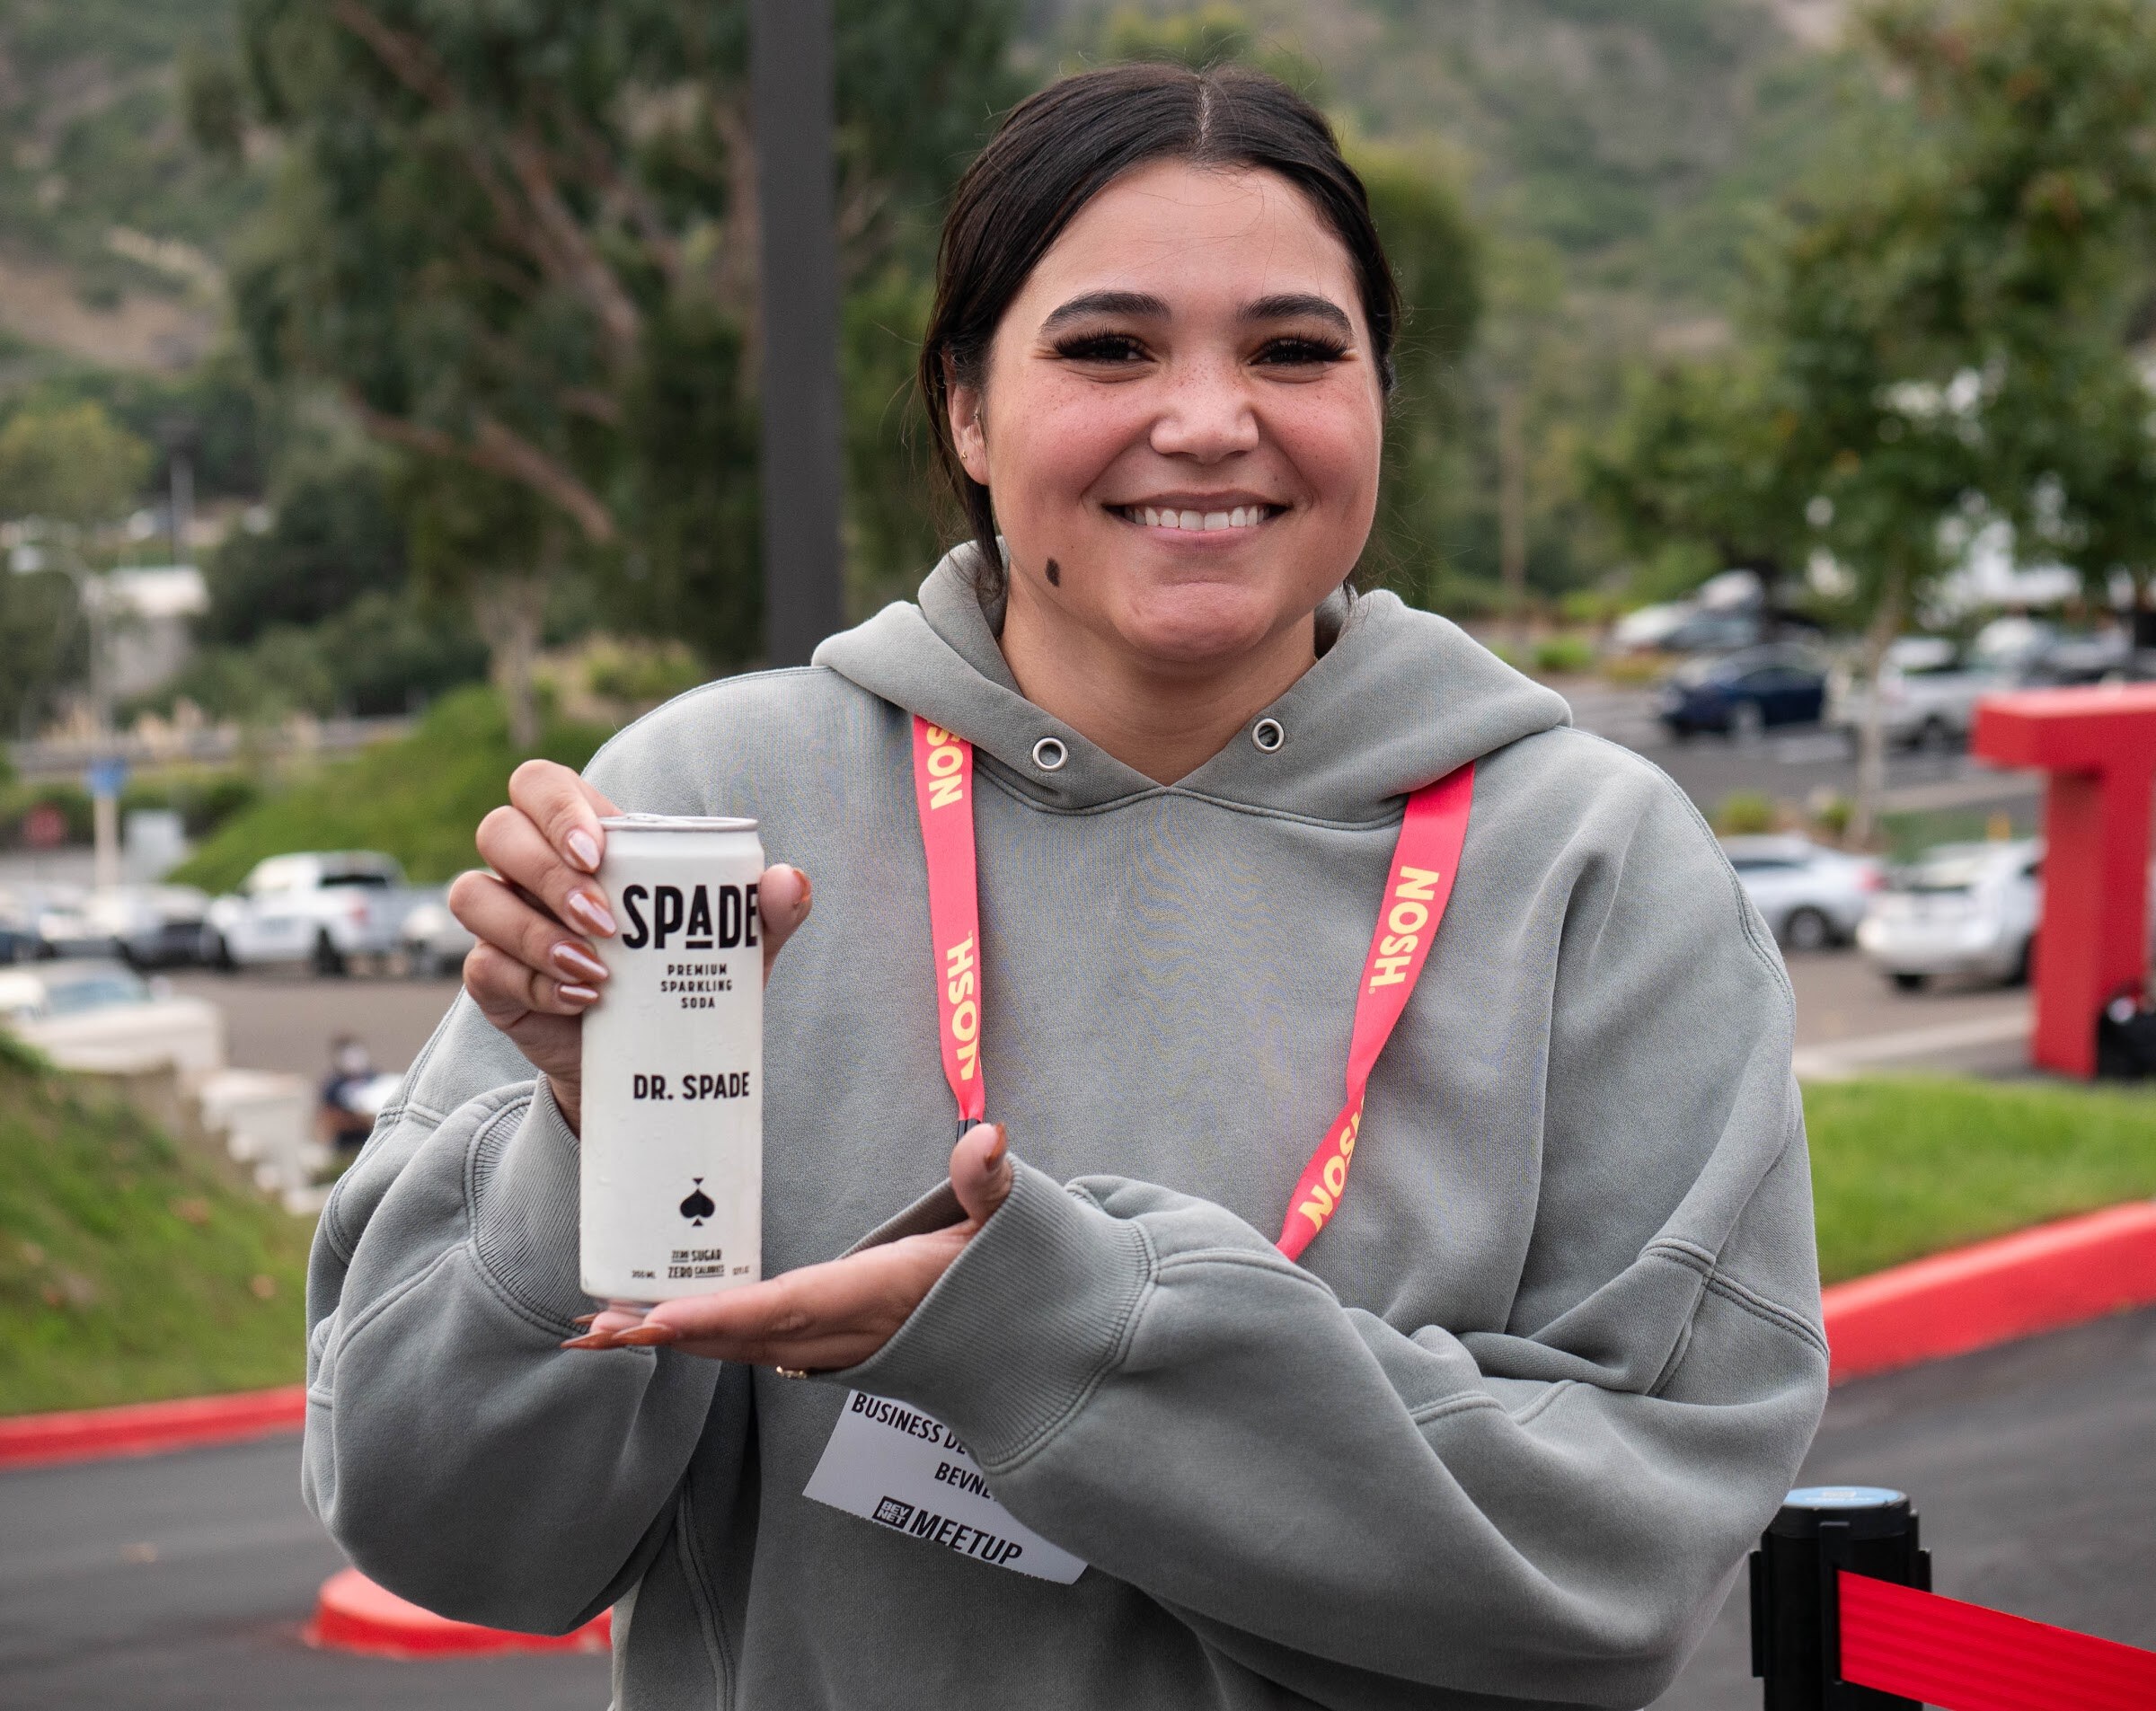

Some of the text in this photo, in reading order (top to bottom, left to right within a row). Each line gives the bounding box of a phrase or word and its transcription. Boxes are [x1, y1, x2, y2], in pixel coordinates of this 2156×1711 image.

[622, 884, 758, 949] SPADE
[667, 964, 728, 976] PREMIUM
[660, 980, 732, 992] SPARKLING
[681, 997, 716, 1009] SODA
[632, 1072, 749, 1099] DR. SPADE
[692, 1248, 722, 1261] SUGAR
[667, 1266, 693, 1278] ZERO
[852, 1392, 943, 1443] BUSINESS
[934, 1461, 993, 1500] BEVN
[876, 1509, 906, 1524] NET
[880, 1501, 909, 1518] BEV
[909, 1509, 1023, 1565] MEETUP
